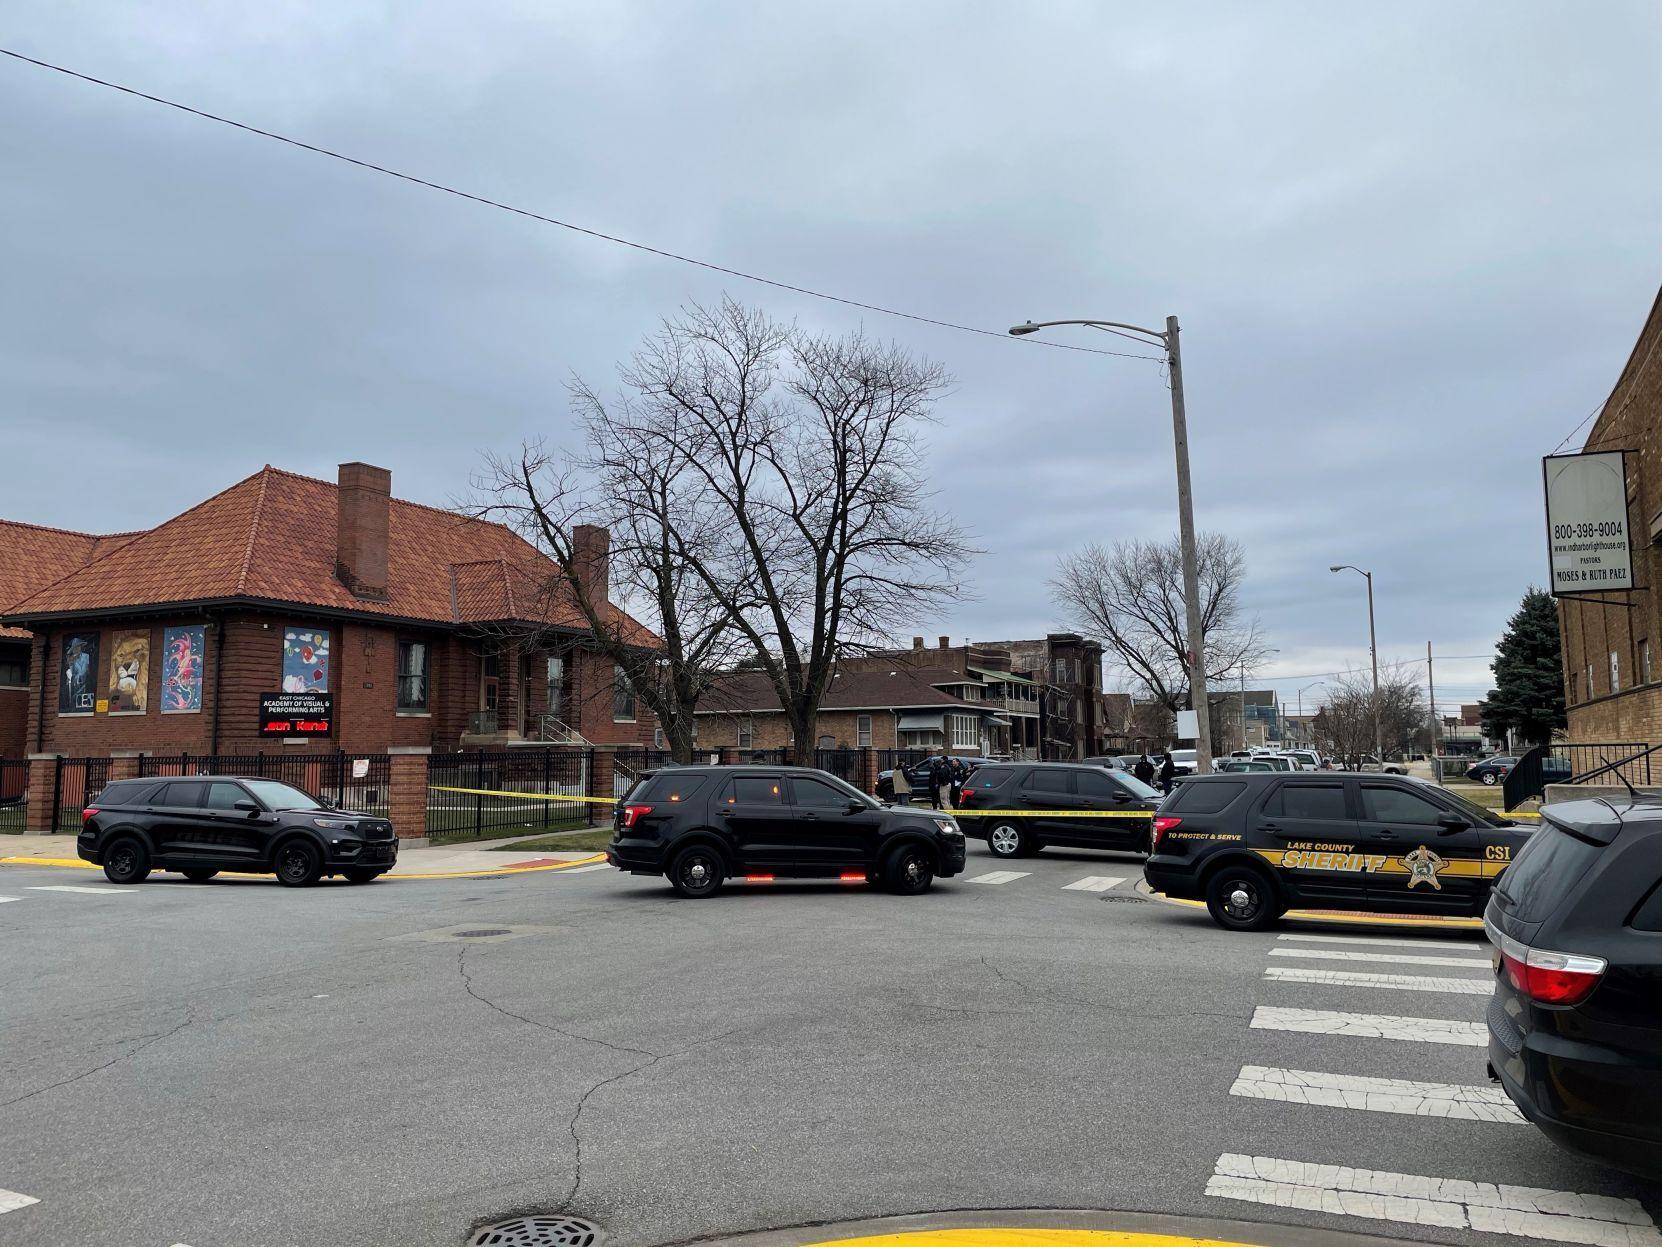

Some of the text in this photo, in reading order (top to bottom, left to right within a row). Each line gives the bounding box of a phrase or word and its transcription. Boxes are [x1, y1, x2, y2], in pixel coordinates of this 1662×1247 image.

[1554, 521, 1623, 540] 800-398-9004
[1580, 556, 1601, 564] PASTORS
[1557, 568, 1626, 582] MOSES & RUTH PAEZ
[1178, 832, 1209, 840] PROTECT
[1287, 841, 1355, 852] LAKE COUNTY
[1485, 845, 1511, 860] CSI
[1281, 850, 1387, 873] SHERIFF
